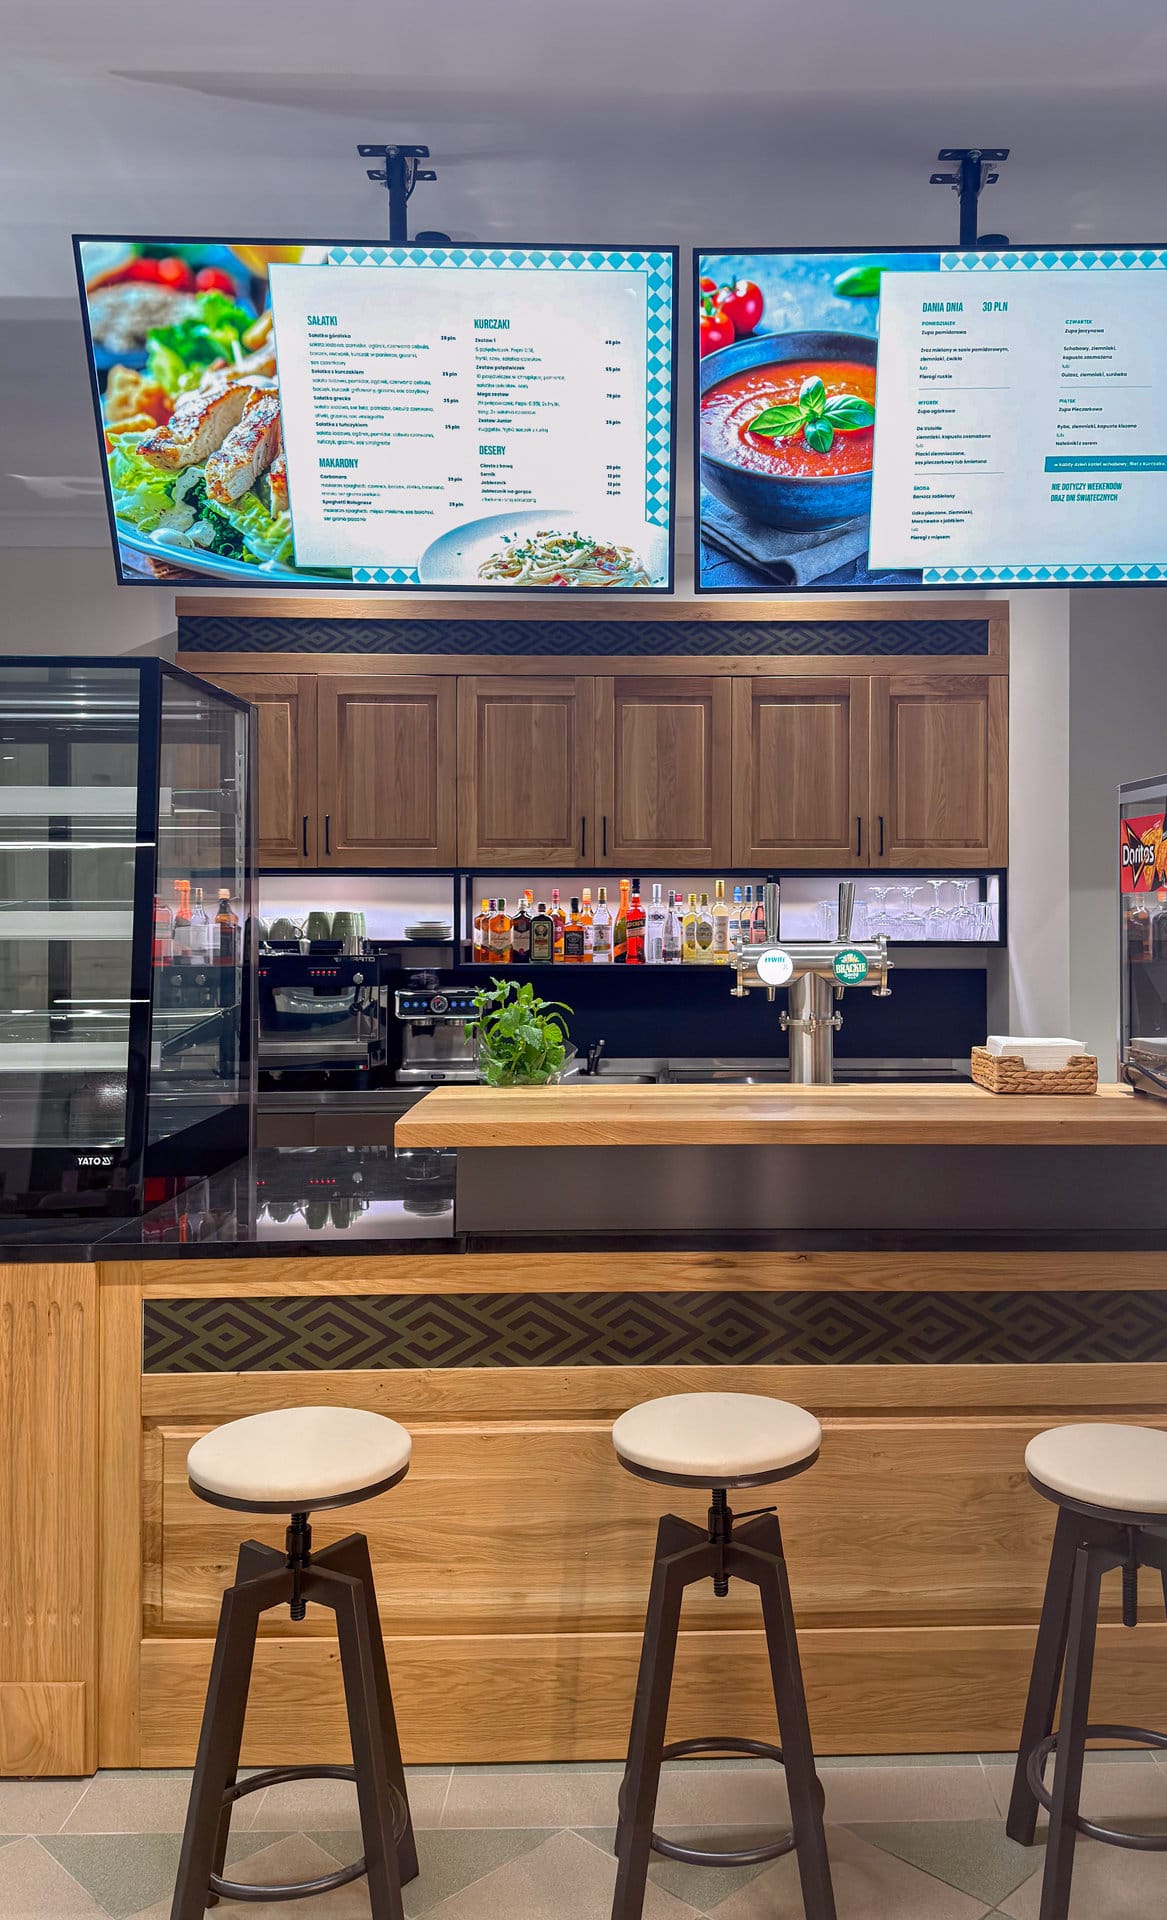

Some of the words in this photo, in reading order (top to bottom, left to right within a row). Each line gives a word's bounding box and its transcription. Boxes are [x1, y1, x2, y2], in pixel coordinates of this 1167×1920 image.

[922, 302, 944, 312] DANIA
[946, 302, 964, 312] DNIA
[982, 302, 992, 312] 30
[994, 302, 1008, 312] PLN
[307, 316, 338, 326] SAŁATKI
[474, 319, 510, 329] KURCZAKI
[479, 446, 506, 455] DESERY
[319, 458, 358, 468] MAKARONY
[1051, 494, 1065, 502] ORAZ
[1066, 494, 1076, 502] DNI
[1076, 494, 1118, 502] ŚWIĄTECZNYCH
[1122, 845, 1154, 866] Doritos
[78, 1157, 101, 1166] YATO
